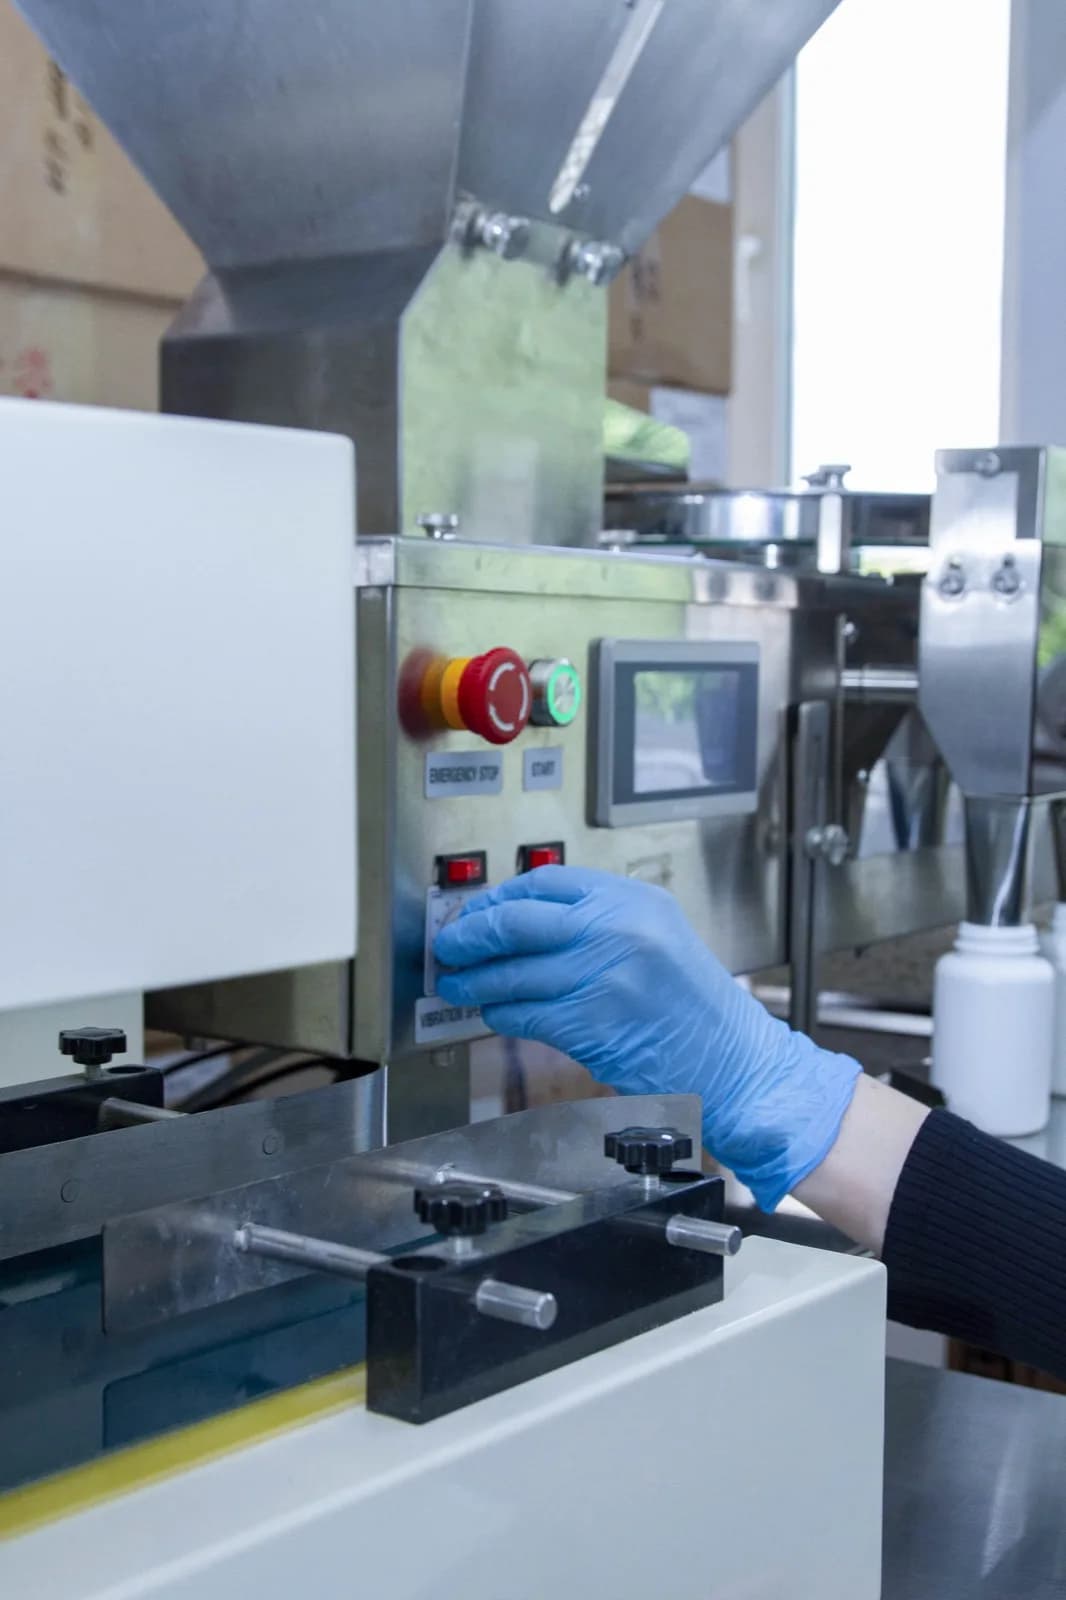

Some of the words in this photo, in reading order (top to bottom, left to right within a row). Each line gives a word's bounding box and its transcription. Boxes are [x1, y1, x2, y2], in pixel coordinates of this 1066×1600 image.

[429, 766, 477, 784] EMERGENCY
[479, 765, 499, 782] STOP
[531, 760, 556, 777] START
[420, 1007, 463, 1028] VIBRATION
